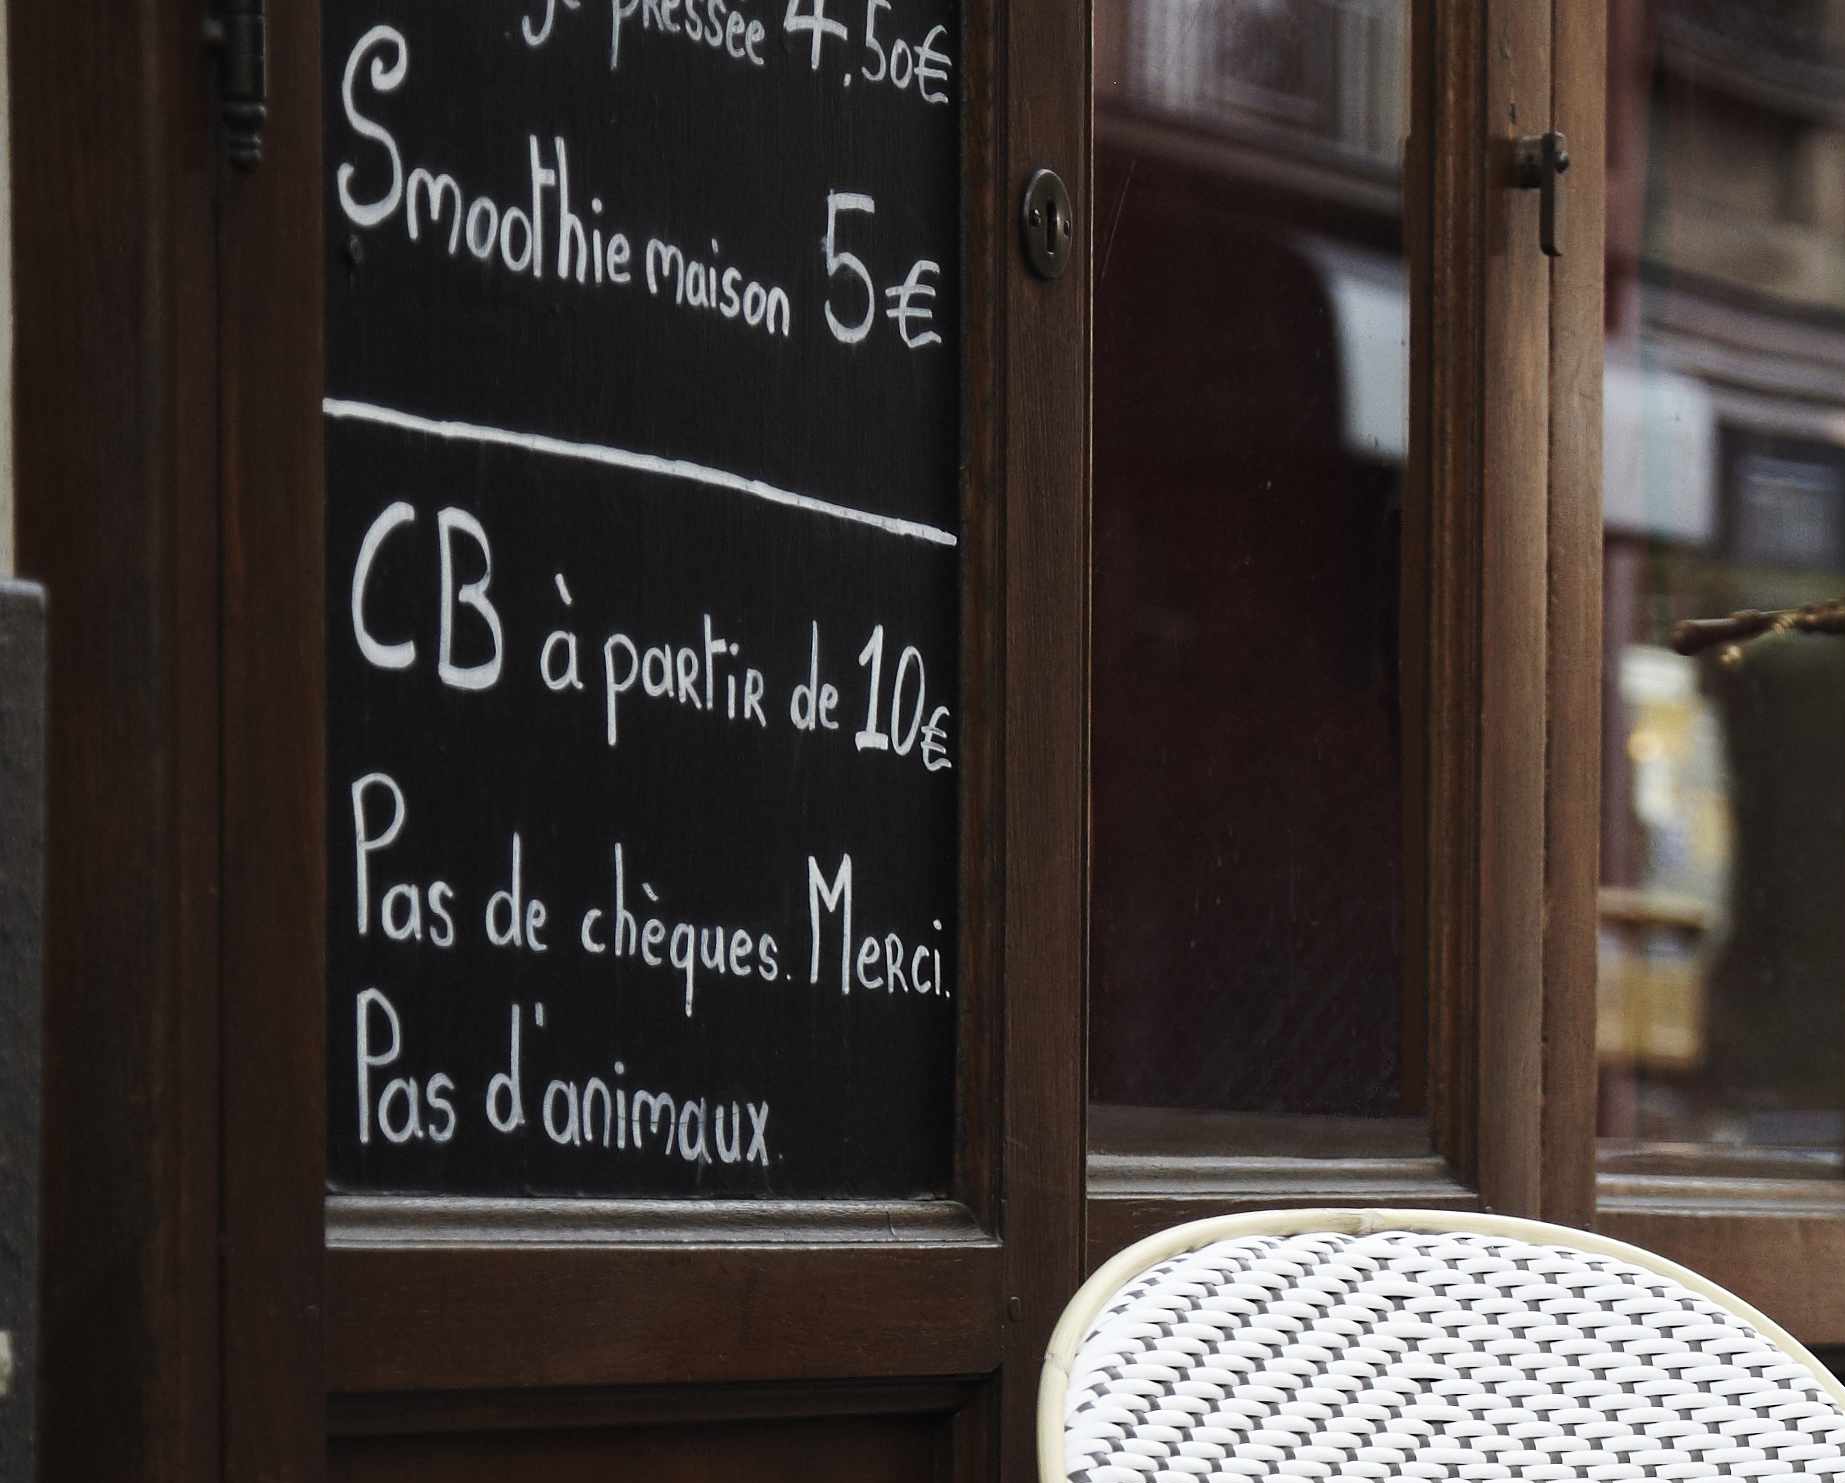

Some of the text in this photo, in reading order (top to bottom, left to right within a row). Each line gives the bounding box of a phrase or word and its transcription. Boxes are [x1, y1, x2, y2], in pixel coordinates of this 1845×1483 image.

[336, 24, 632, 285] Smoothie
[645, 237, 791, 337] maison
[351, 501, 504, 691] CB
[539, 572, 585, 691] à
[790, 619, 840, 732] de
[854, 623, 953, 772] 10€
[351, 772, 455, 947] Pas
[485, 831, 548, 952] de
[356, 987, 770, 1168] Pas d'animaux
